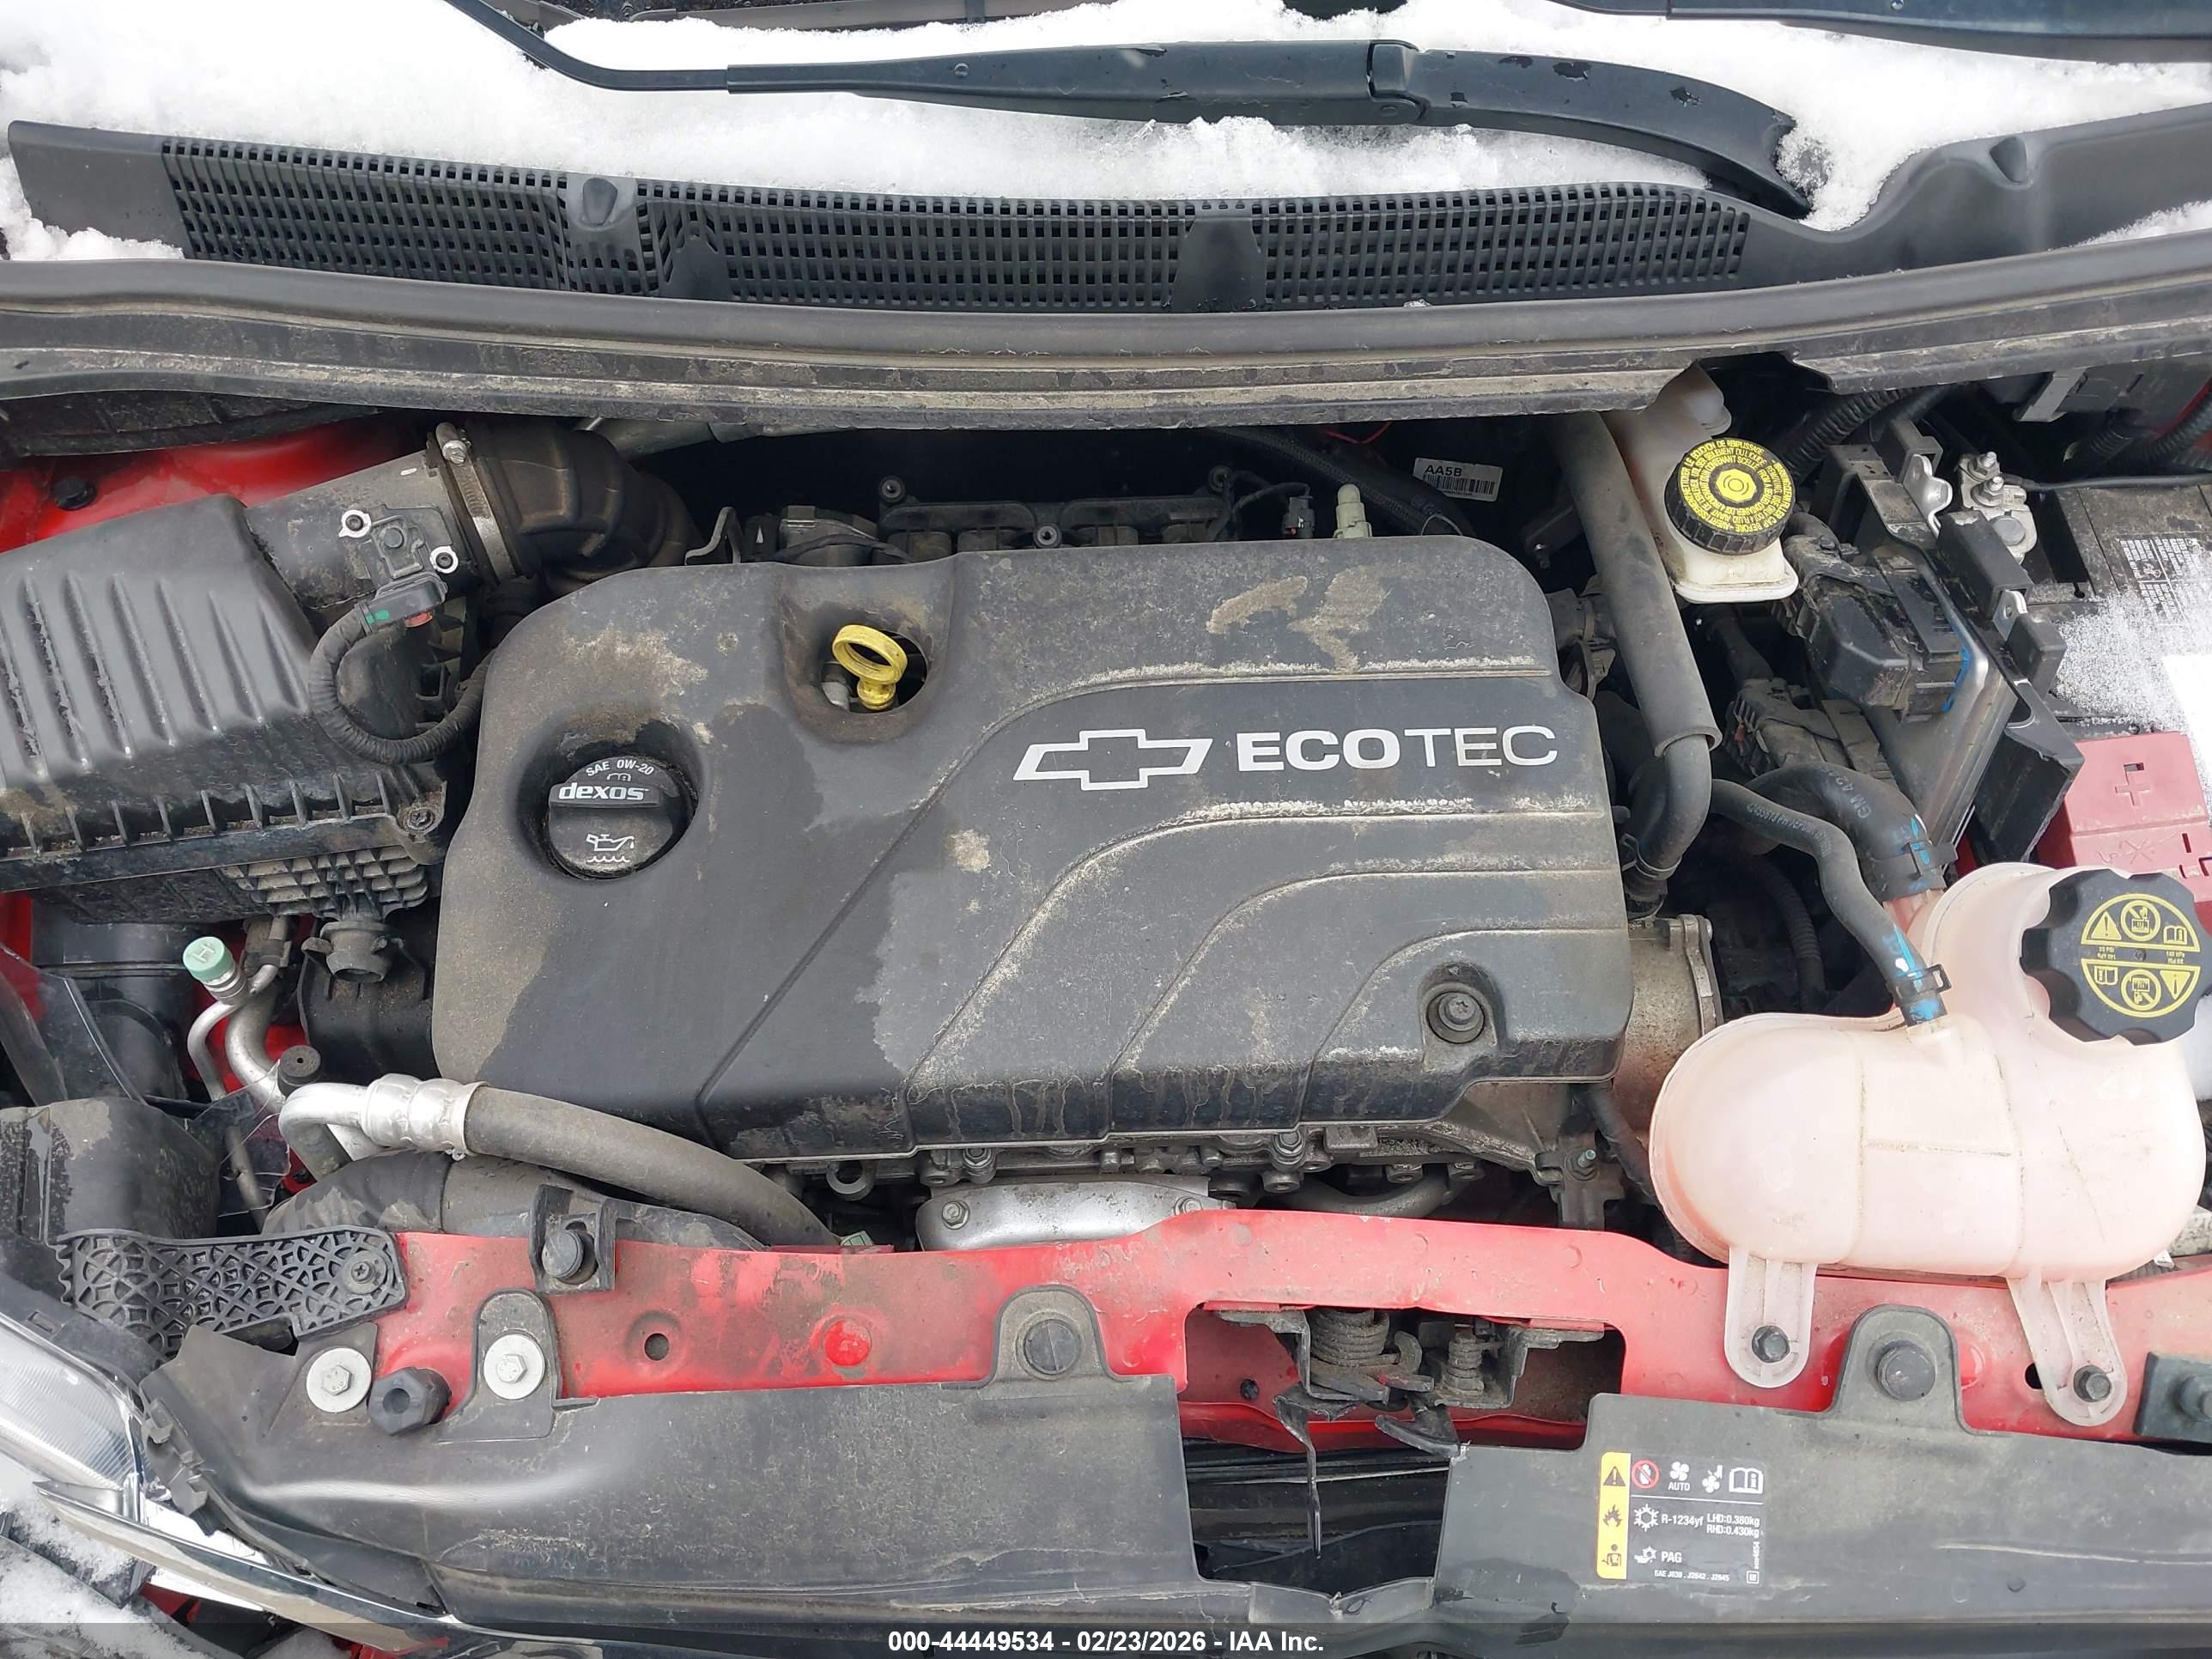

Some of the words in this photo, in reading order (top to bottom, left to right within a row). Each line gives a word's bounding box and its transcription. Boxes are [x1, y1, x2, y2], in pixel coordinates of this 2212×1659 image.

[1425, 465, 1462, 477] AA5B
[1237, 725, 1558, 771] ECOTEC
[586, 760, 611, 776] SAE
[617, 759, 654, 775] 0W-20
[558, 782, 645, 800] dexos
[192, 944, 215, 963] H
[1668, 1482, 1691, 1492] AUTO
[1661, 1513, 1705, 1528] R-1234yf
[1662, 1552, 1683, 1563] PAG
